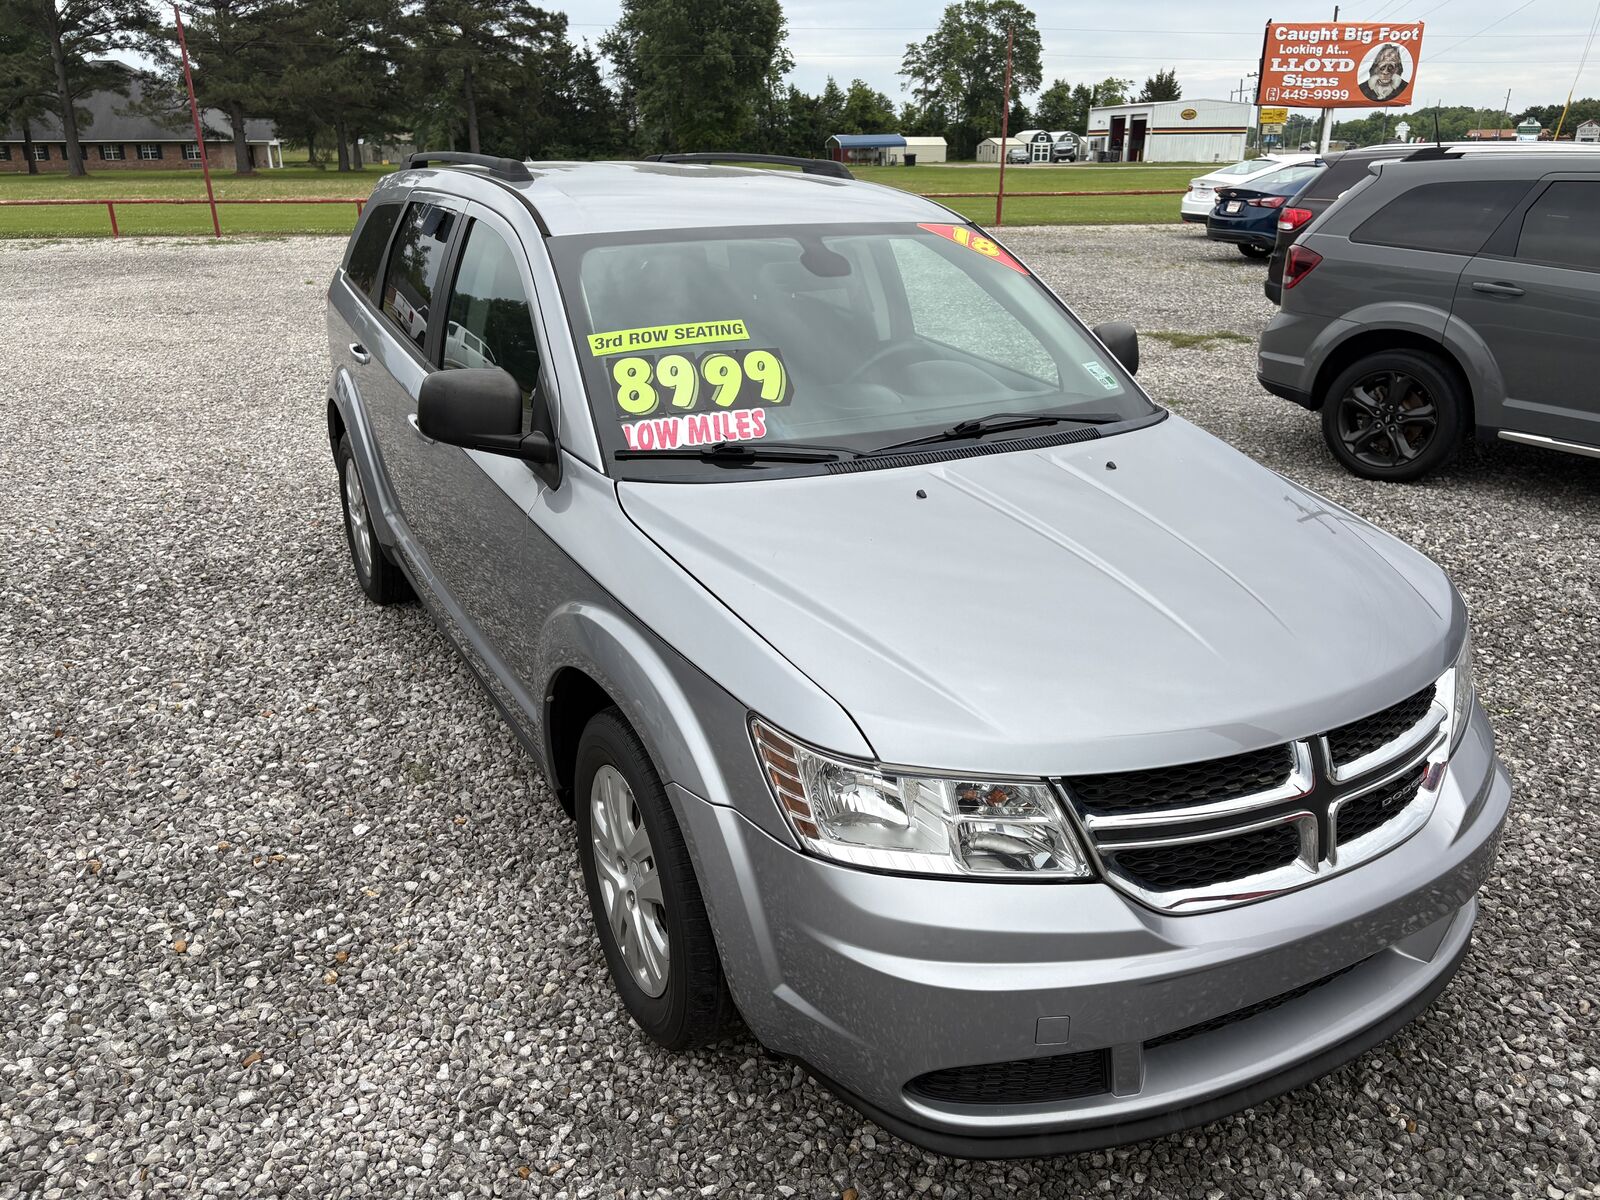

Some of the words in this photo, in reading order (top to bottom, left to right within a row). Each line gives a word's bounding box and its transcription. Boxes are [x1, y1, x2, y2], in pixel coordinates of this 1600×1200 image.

[1275, 27, 1339, 43] Caught
[1344, 27, 1373, 44] Big
[1378, 27, 1419, 41] Foot
[1279, 44, 1323, 56] Looking
[1326, 45, 1349, 55] At...
[1270, 58, 1355, 72] LLOYD
[1282, 74, 1339, 89] Signs
[1281, 89, 1349, 100] 449-9999
[953, 226, 1000, 257] 18
[594, 335, 623, 350] 3rd
[629, 329, 668, 345] ROW
[674, 323, 743, 340] SEATING
[613, 350, 787, 415] 8999
[624, 419, 679, 450] LOW
[688, 410, 766, 445] MILES
